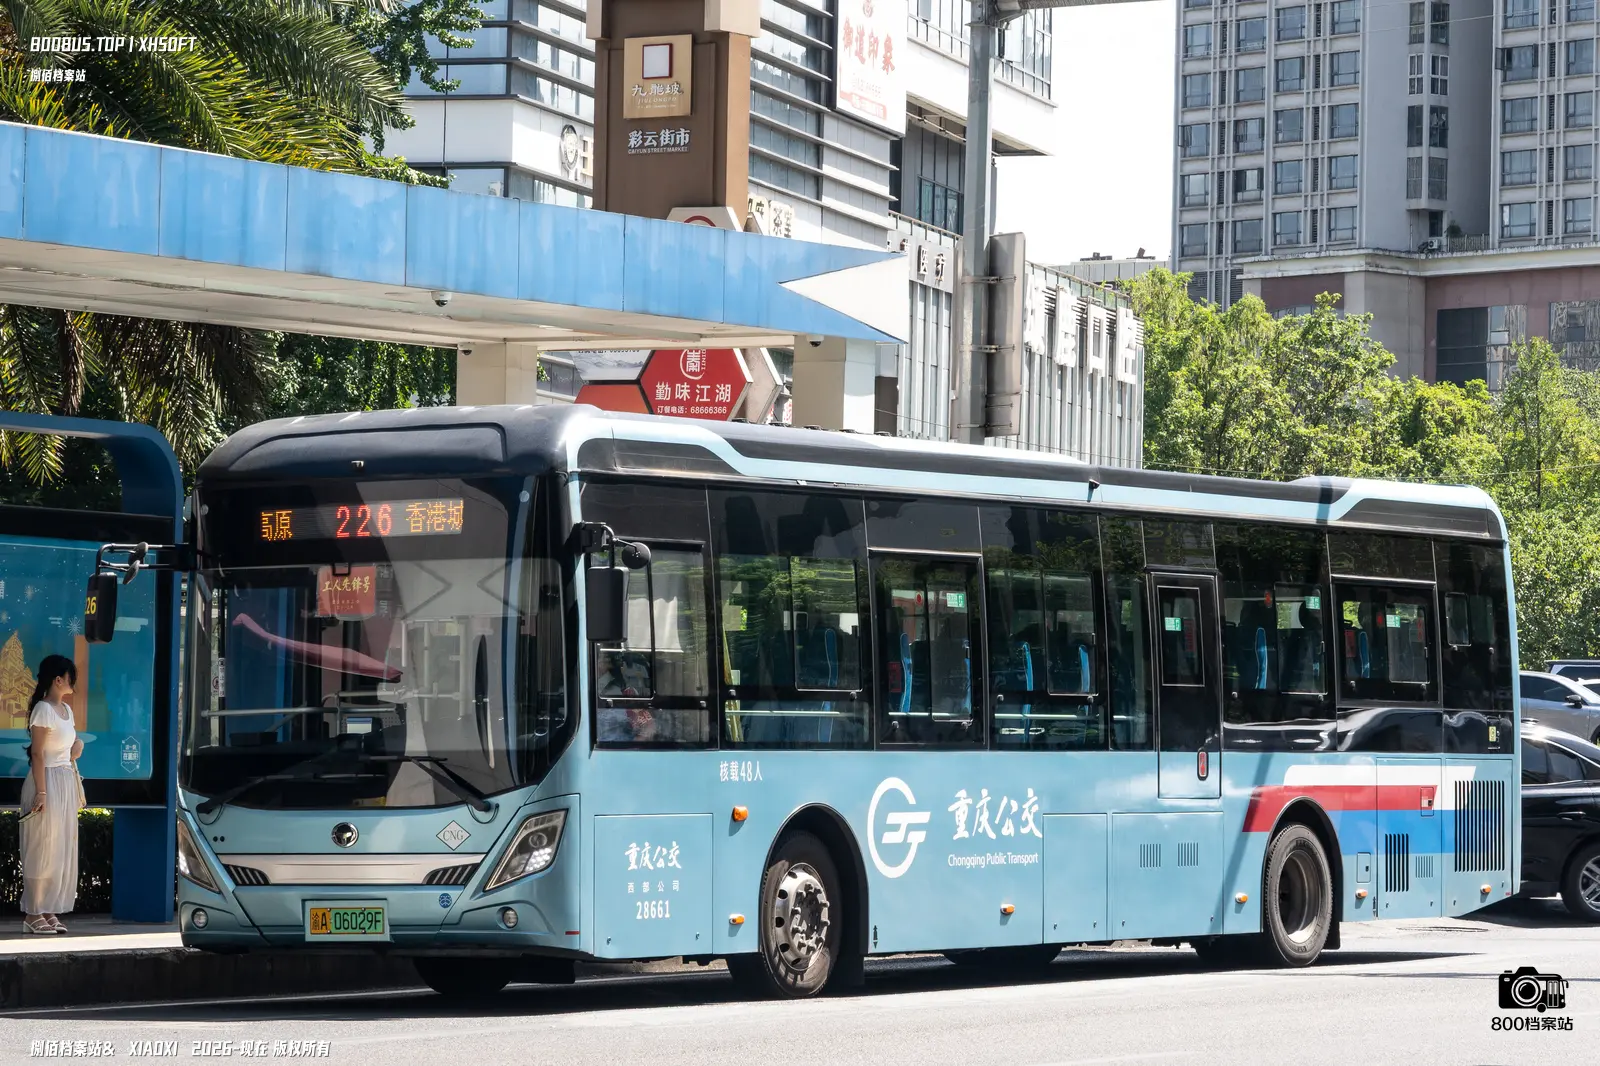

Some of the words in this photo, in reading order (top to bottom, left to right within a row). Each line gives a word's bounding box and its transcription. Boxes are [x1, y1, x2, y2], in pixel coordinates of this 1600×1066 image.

[627, 128, 691, 148] 彩云街市
[655, 381, 731, 403] 勤味江湖
[336, 504, 392, 538] 226
[405, 499, 464, 533] 香港城
[322, 574, 371, 594] 工人先锋号
[719, 761, 763, 782] 核载48人
[948, 787, 1043, 841] 重庆公交
[442, 829, 464, 841] CNG
[625, 840, 682, 871] 重庆公交
[948, 854, 986, 869] Chongqing
[986, 853, 1007, 866] Public
[1007, 852, 1039, 869] Transport
[627, 880, 680, 894] 西部公司
[636, 899, 671, 920] 28661
